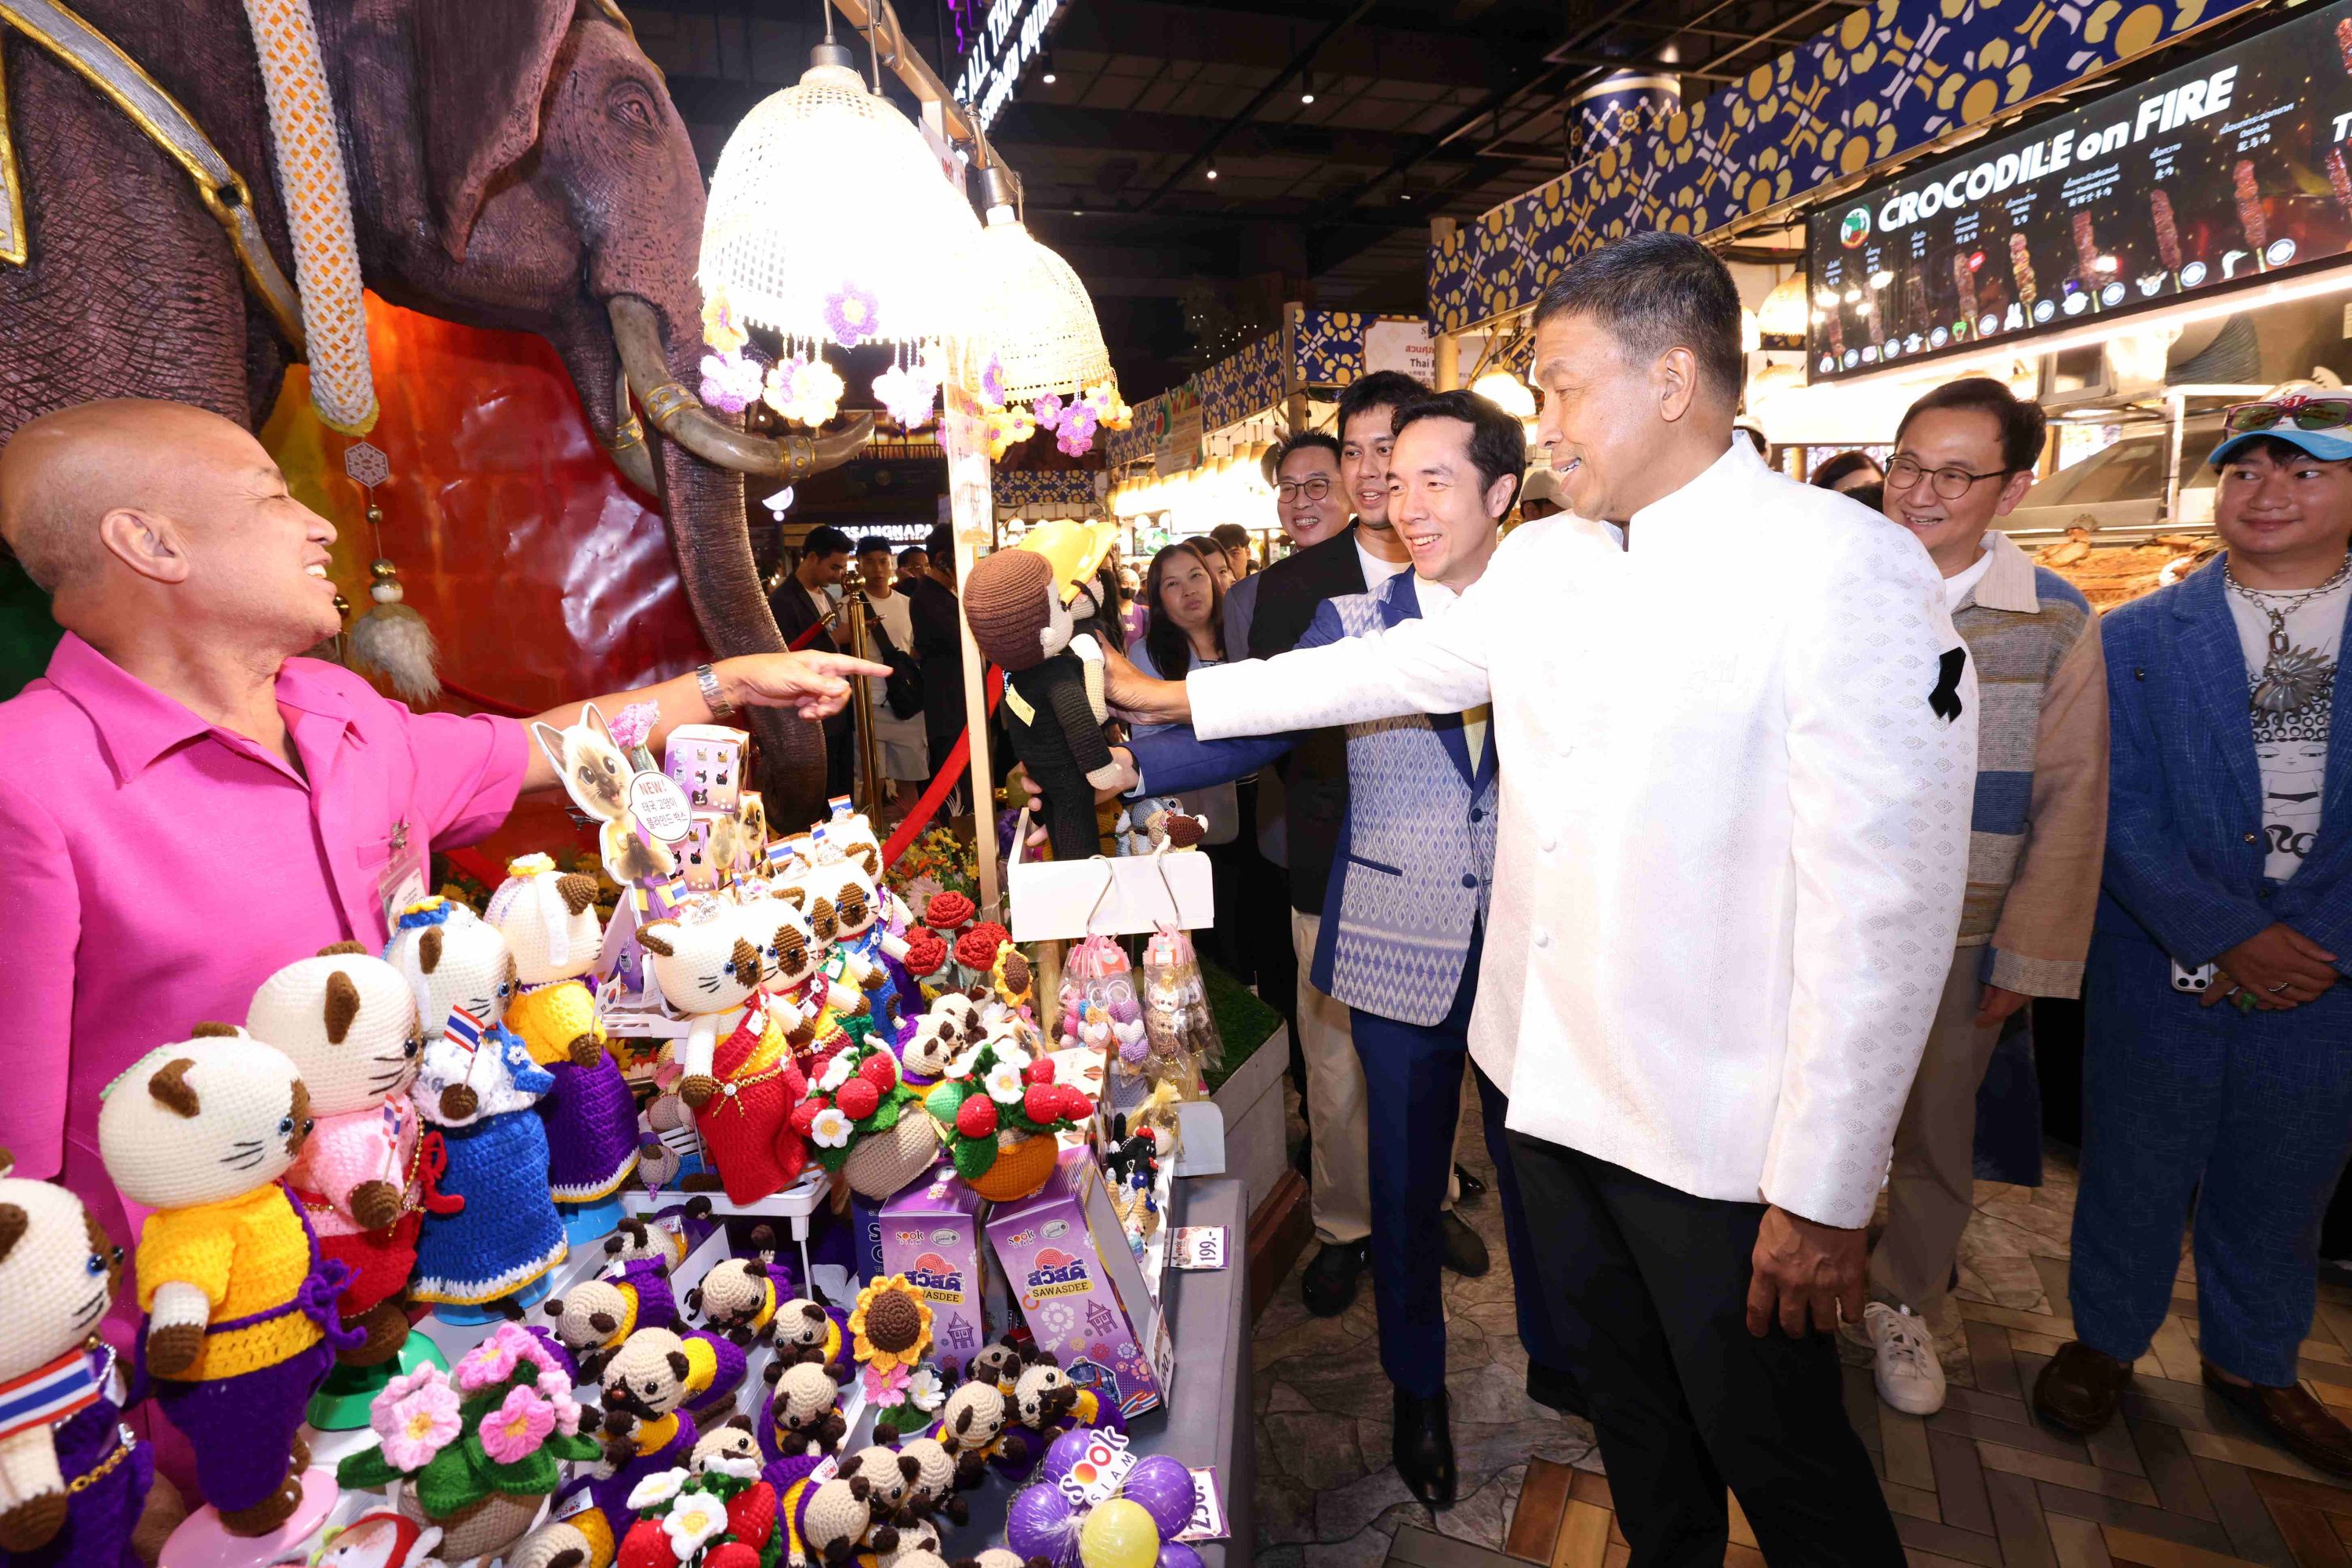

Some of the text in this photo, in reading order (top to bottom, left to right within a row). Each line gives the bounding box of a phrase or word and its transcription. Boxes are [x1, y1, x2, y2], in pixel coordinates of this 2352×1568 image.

[1878, 64, 2238, 232] CROCODILE on FIRE
[1410, 358, 1429, 368] Thai
[638, 779, 669, 796] NEW!
[641, 797, 678, 814] 태국 고양이
[646, 811, 688, 829] 블라인드 박스
[1027, 1258, 1088, 1287] สวัสดี
[1033, 1282, 1089, 1298] SAWASDEE
[1091, 1454, 1134, 1501] SIAM
